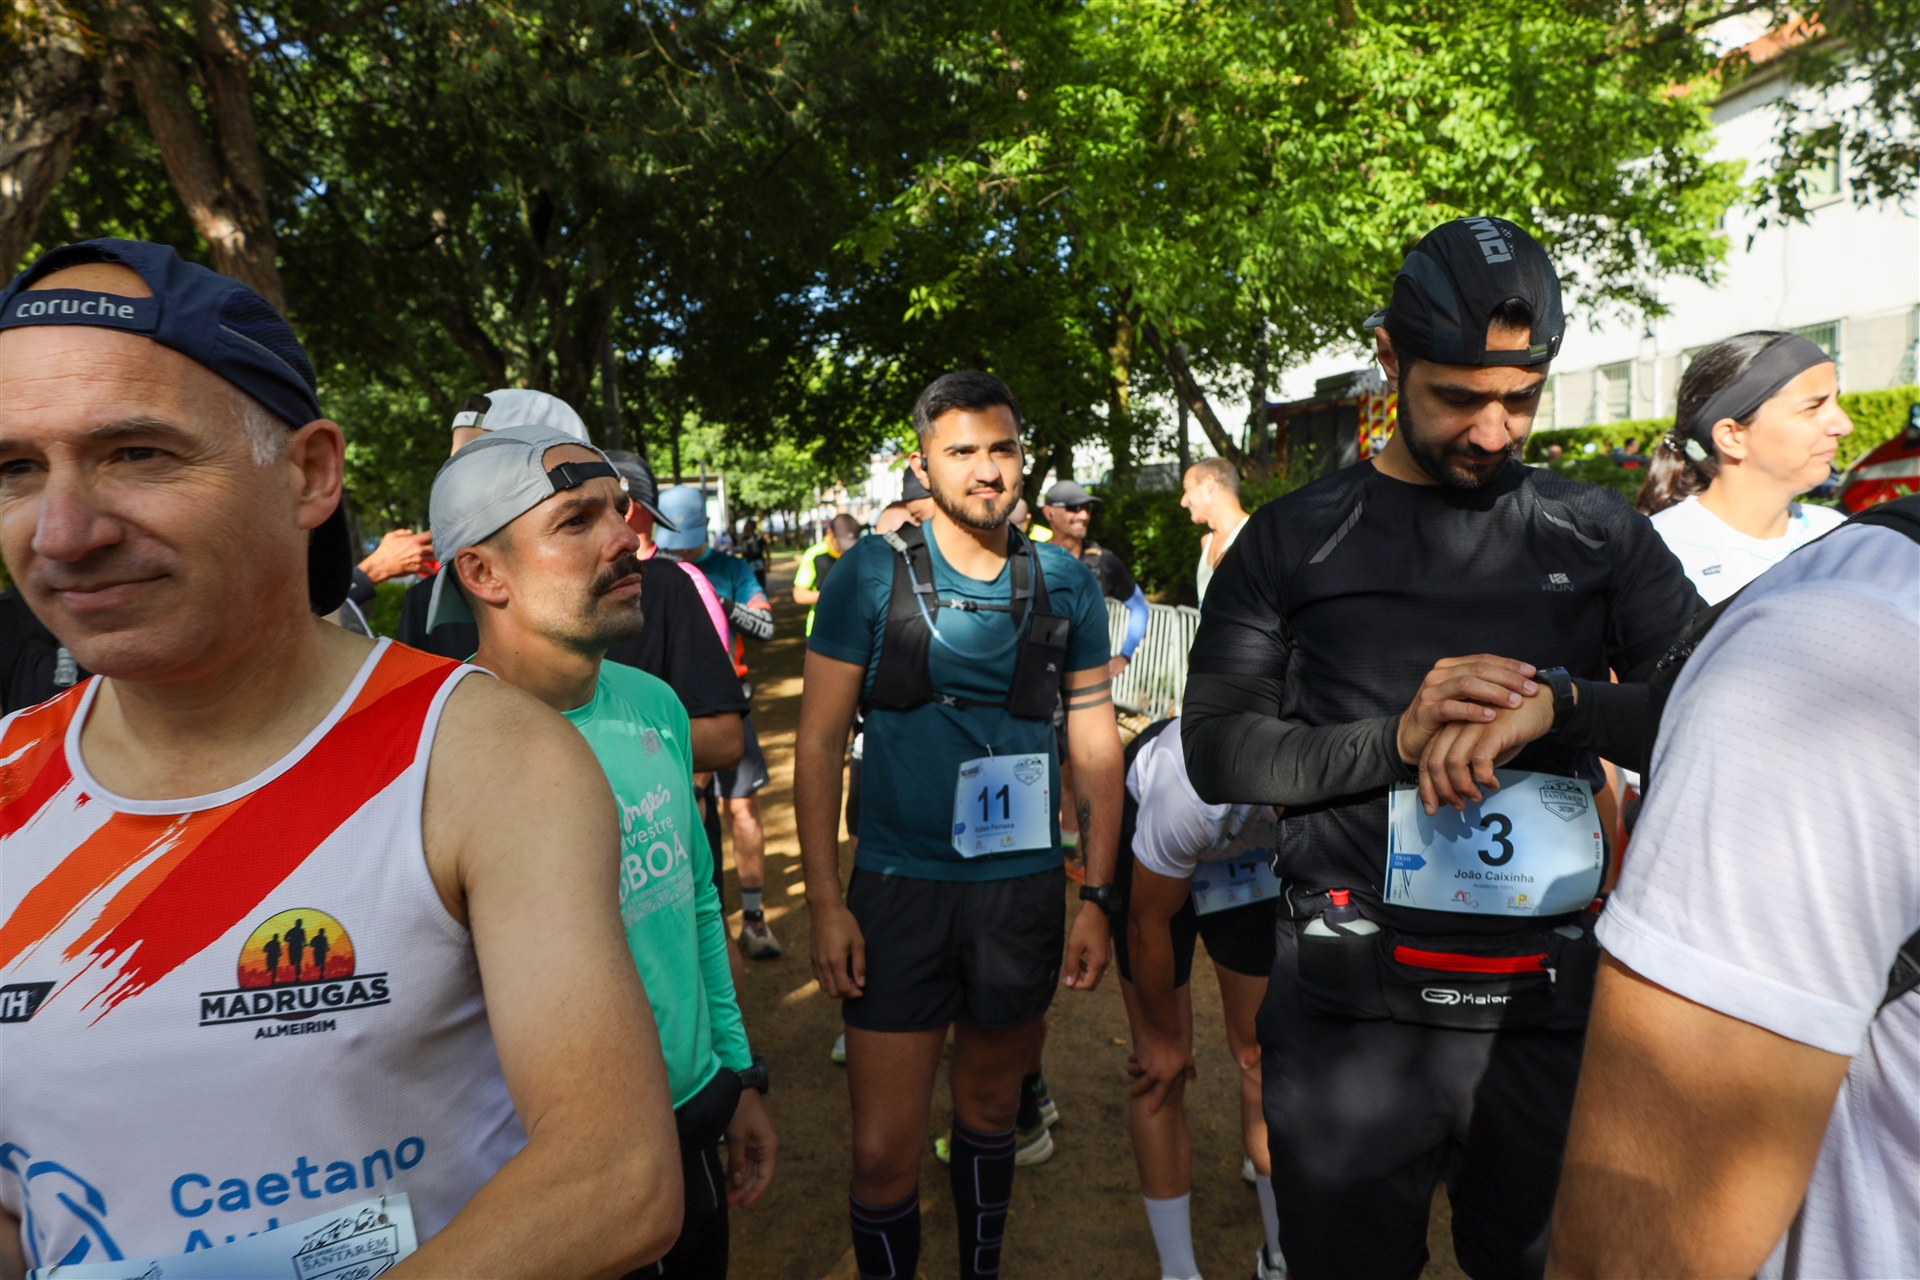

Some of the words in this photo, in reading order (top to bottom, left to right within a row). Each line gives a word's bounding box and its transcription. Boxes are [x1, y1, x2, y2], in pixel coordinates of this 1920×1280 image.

[15, 296, 135, 320] coruche
[1542, 584, 1575, 592] RUN
[978, 784, 1010, 822] 11
[621, 816, 674, 851] lvestre
[1477, 812, 1514, 867] 3
[1454, 869, 1482, 880] João
[1485, 871, 1535, 883] Caixinha
[201, 978, 391, 1021] MADRUGAS
[254, 1018, 337, 1040] ALMEIRIM
[170, 1135, 426, 1218] Caetano
[301, 1235, 389, 1272] SANTARÉM
